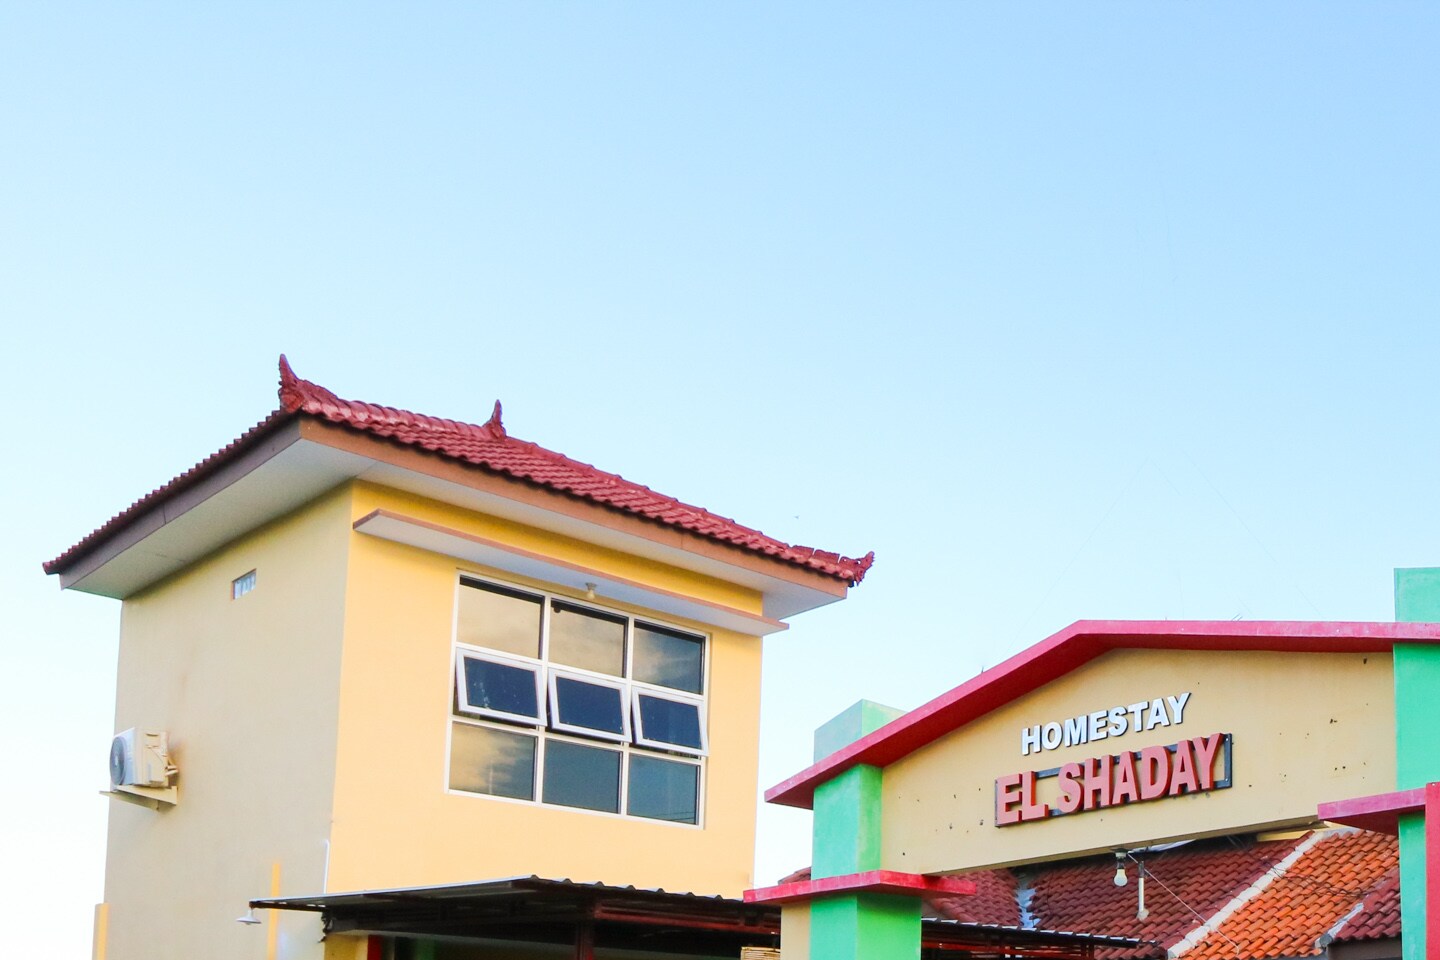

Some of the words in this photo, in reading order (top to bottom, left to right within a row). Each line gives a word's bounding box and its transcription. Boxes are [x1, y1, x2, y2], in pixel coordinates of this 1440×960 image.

[1021, 692, 1192, 756] HOMESTAY
[996, 770, 1049, 826] EL
[1056, 732, 1225, 814] SHADAY
